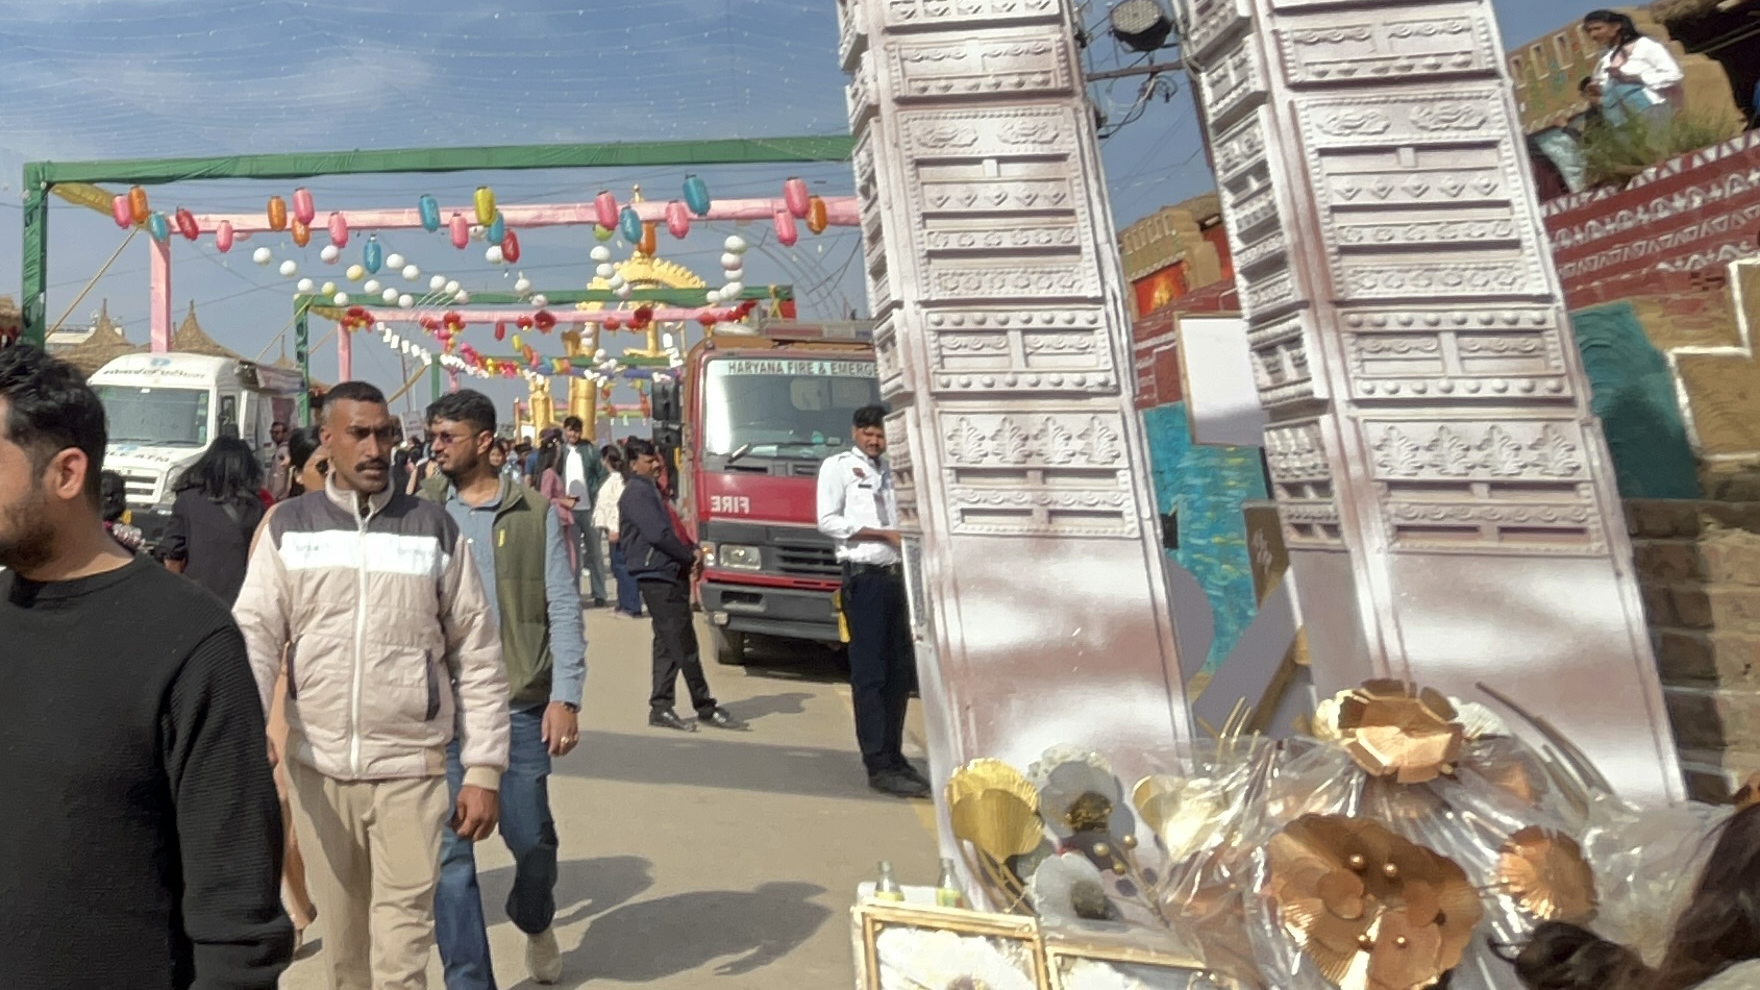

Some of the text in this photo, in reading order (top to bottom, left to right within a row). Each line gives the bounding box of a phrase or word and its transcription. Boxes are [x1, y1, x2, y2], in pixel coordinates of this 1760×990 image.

[728, 361, 784, 374] HARYANA
[788, 362, 815, 375] FIRE
[818, 362, 828, 374] &
